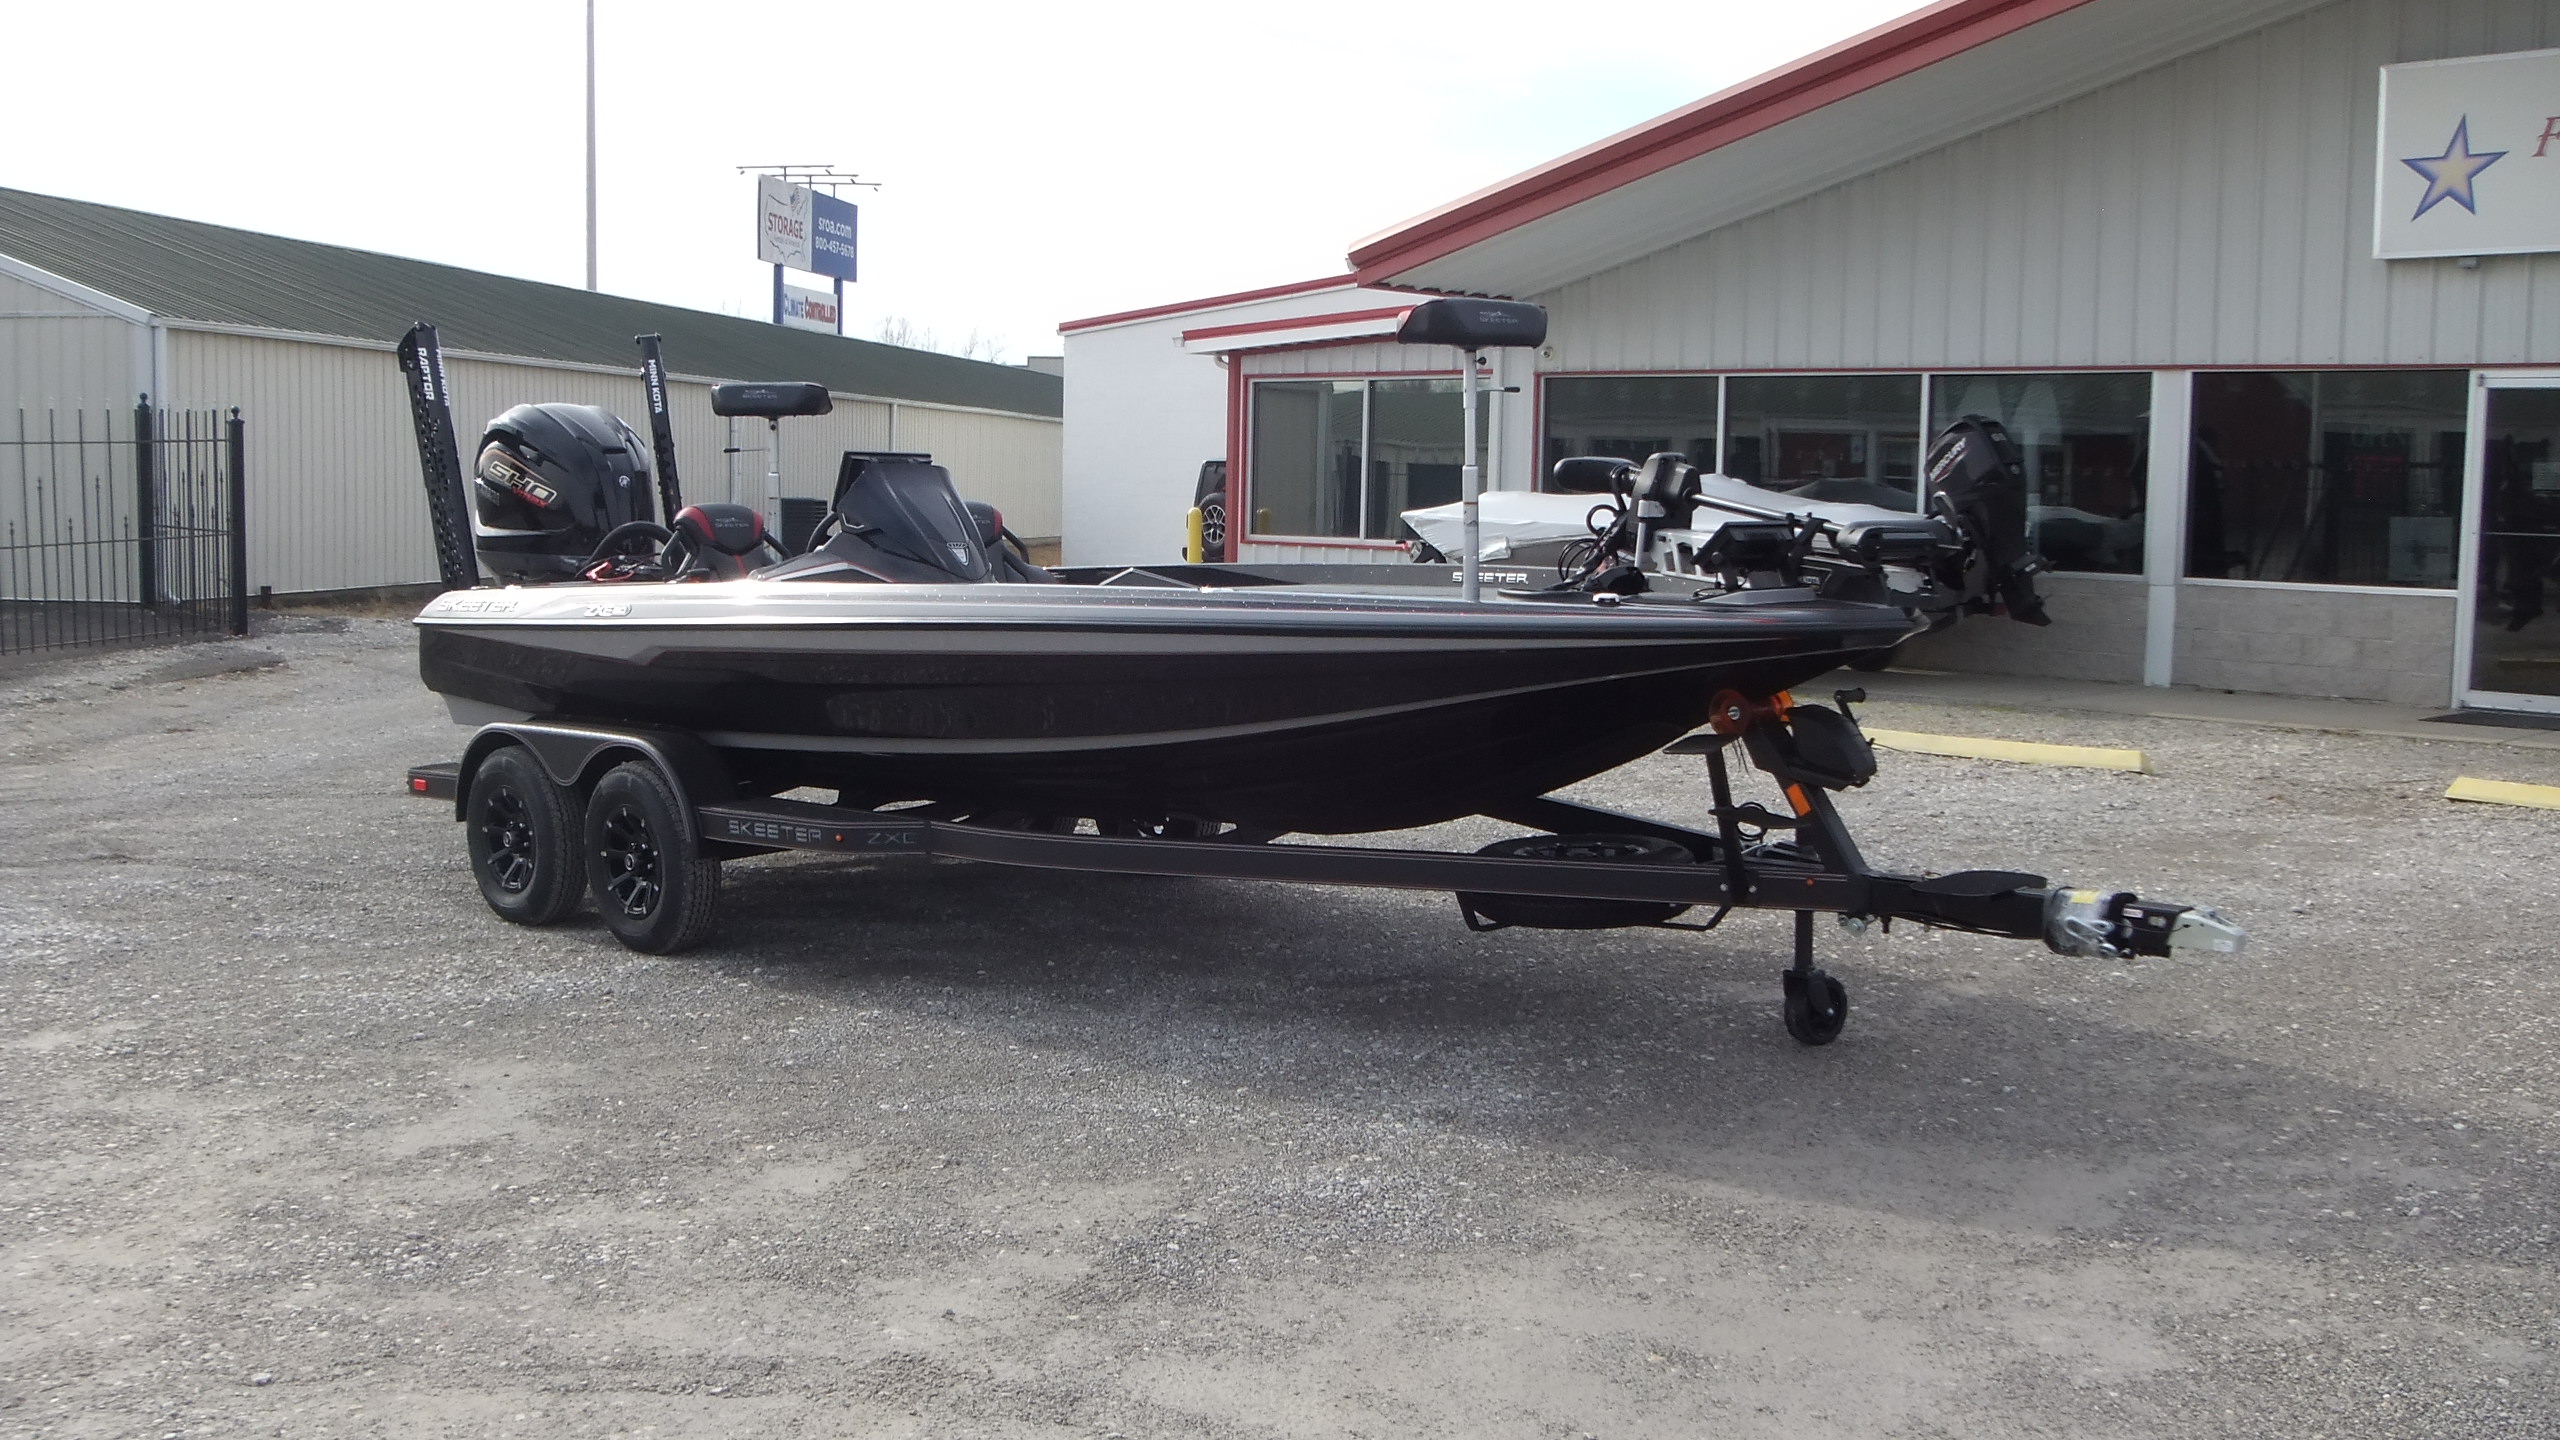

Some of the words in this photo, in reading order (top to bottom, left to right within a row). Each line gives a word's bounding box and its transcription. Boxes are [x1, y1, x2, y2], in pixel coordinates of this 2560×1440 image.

[768, 212, 804, 240] STORAGE
[818, 216, 852, 239] sroa.com
[805, 295, 836, 324] CONTROLLED
[417, 347, 435, 401] RAPTOR
[648, 359, 660, 386] MINN
[652, 387, 663, 414] KOTA
[1929, 436, 1967, 482] MERCURY
[489, 460, 557, 503] SHO
[1451, 571, 1527, 584] SEETER
[727, 819, 822, 843] SKEETER
